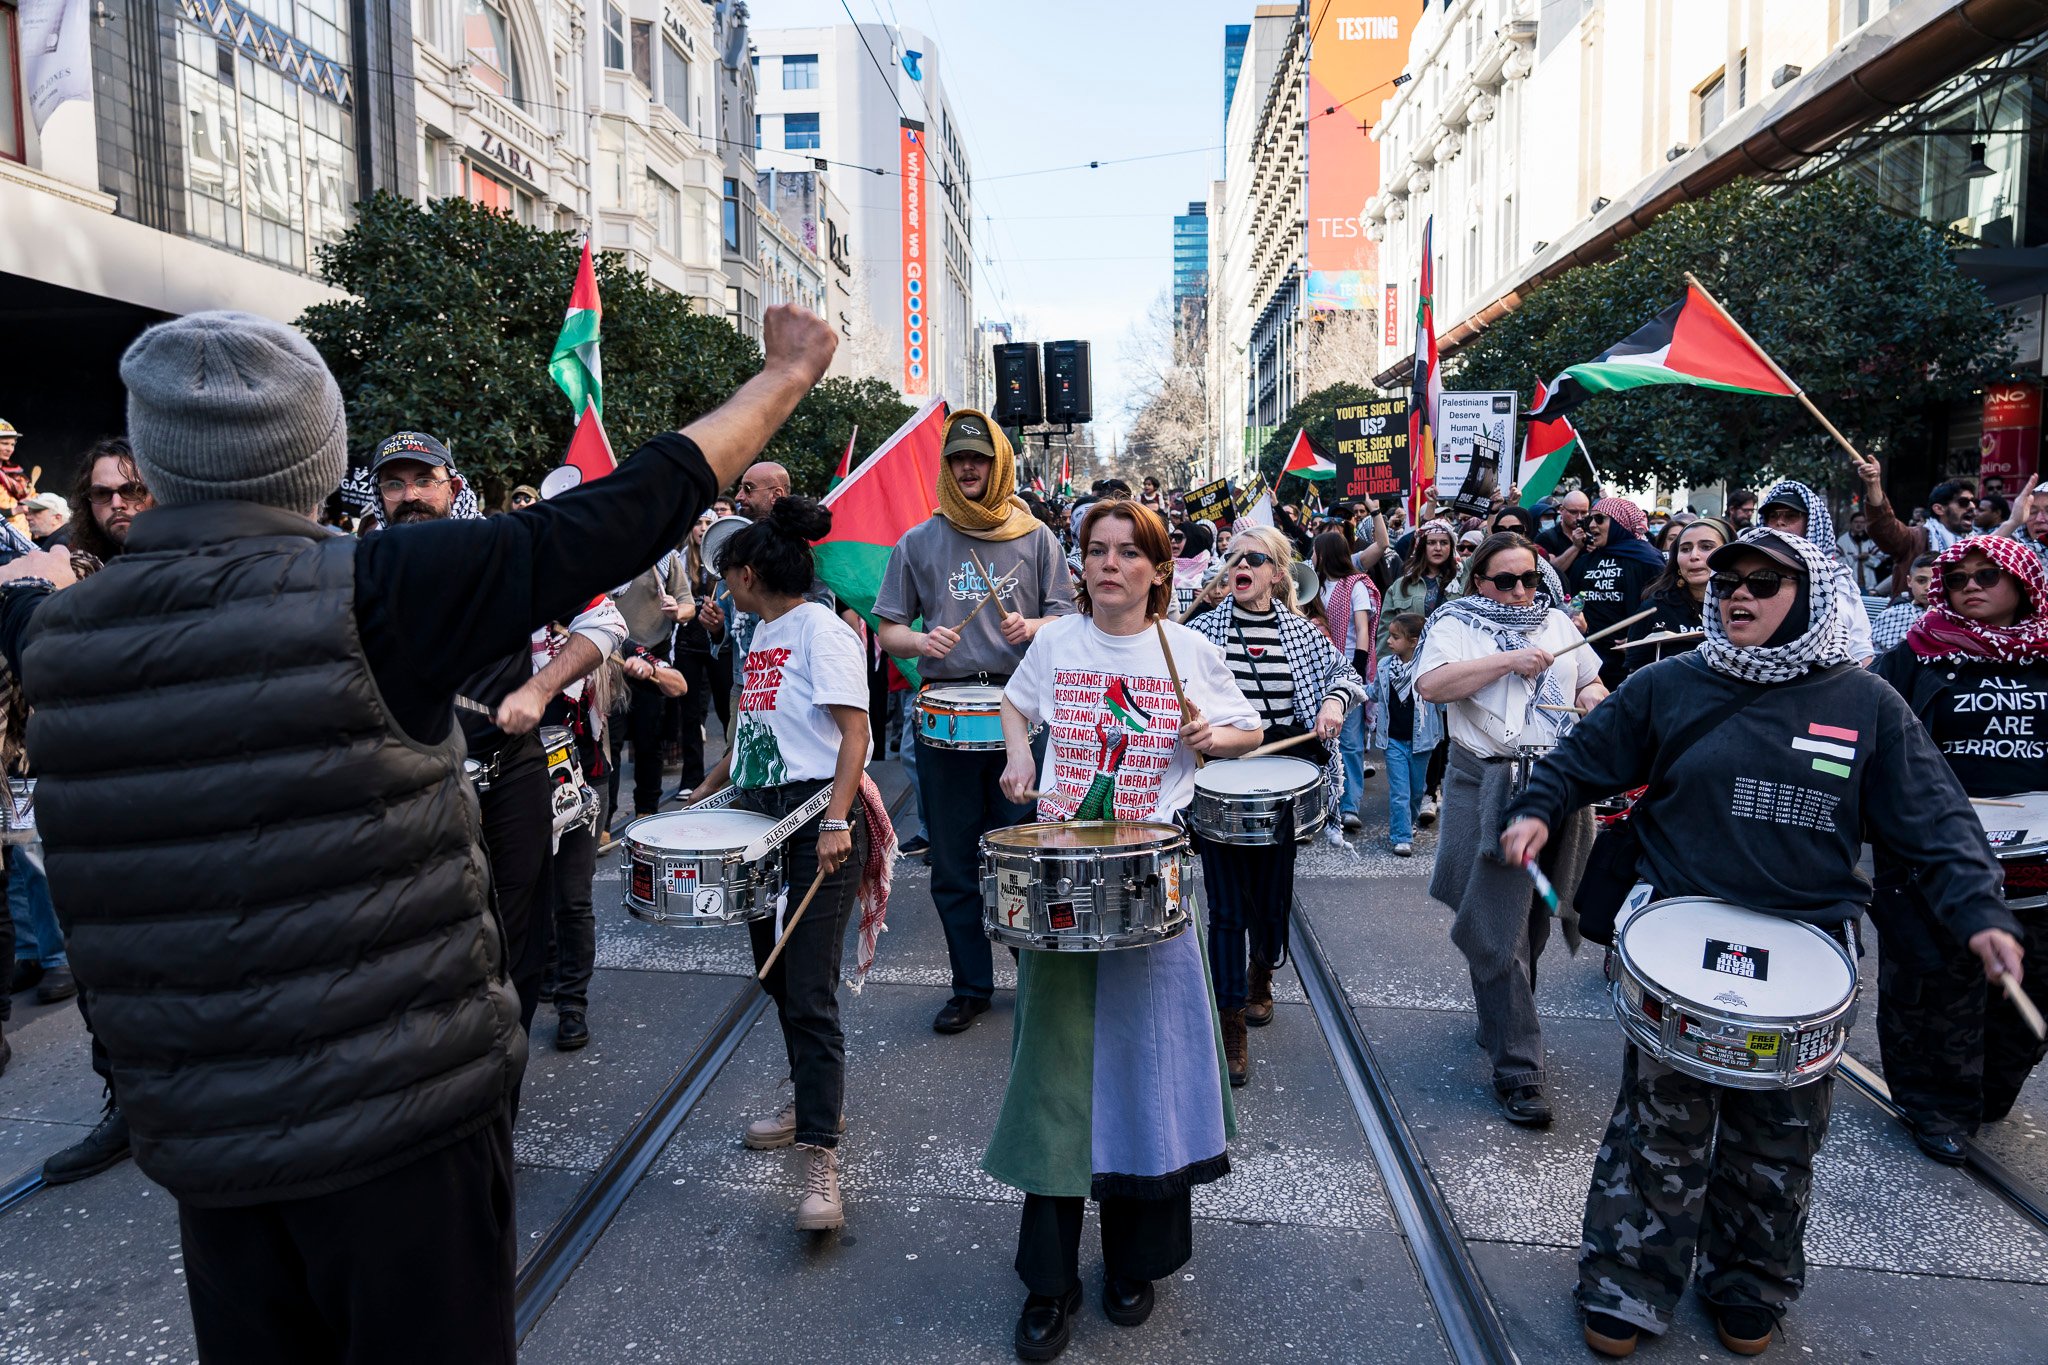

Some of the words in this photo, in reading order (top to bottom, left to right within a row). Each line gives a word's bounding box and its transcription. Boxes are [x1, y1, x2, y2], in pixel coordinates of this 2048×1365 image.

[664, 6, 695, 54] ZARA
[1336, 16, 1398, 40] TESTING
[480, 130, 535, 182] ZARA
[908, 152, 919, 229] wherever
[909, 233, 920, 258] we
[1387, 289, 1397, 343] VAPIANO
[1336, 405, 1368, 420] YOU'RE
[1370, 402, 1392, 416] SICK
[1394, 401, 1406, 414] OF
[1360, 417, 1386, 435] US?
[382, 446, 403, 457] WILL
[407, 444, 431, 453] FALL
[384, 439, 424, 450] COLONY
[1338, 438, 1368, 454] WE'RE
[1370, 436, 1392, 451] SICK
[1395, 434, 1407, 448] OF
[1353, 465, 1392, 481] KILLING
[1347, 478, 1400, 496] CHILDREN!
[1200, 493, 1216, 507] US?
[1597, 558, 1617, 568] ALL
[1584, 567, 1623, 579] ZIONIST
[1594, 579, 1615, 590] ARE
[1584, 591, 1624, 602] ERRORIST
[1056, 672, 1102, 687] RESISTANCE
[1132, 679, 1178, 694] LIBERATIO
[1979, 676, 2028, 690] ALL
[1055, 689, 1101, 703] RESISTANCE
[1953, 692, 2048, 713] ZIONIST
[1983, 716, 2034, 735] ARE
[1122, 754, 1171, 769] LIBERATION
[698, 787, 739, 810] ALESTINE
[764, 814, 800, 846] ALESTINE
[804, 797, 823, 816] FREE
[1001, 882, 1028, 898] PALESTINE
[1720, 952, 1738, 961] THE
[1726, 943, 1747, 954] IDF
[1717, 957, 1755, 971] DEATH
[1740, 956, 1753, 964] TO
[1716, 964, 1755, 978] DEATH
[1800, 1023, 1836, 1043] BABY
[1702, 1053, 1730, 1065] PALESTINE
